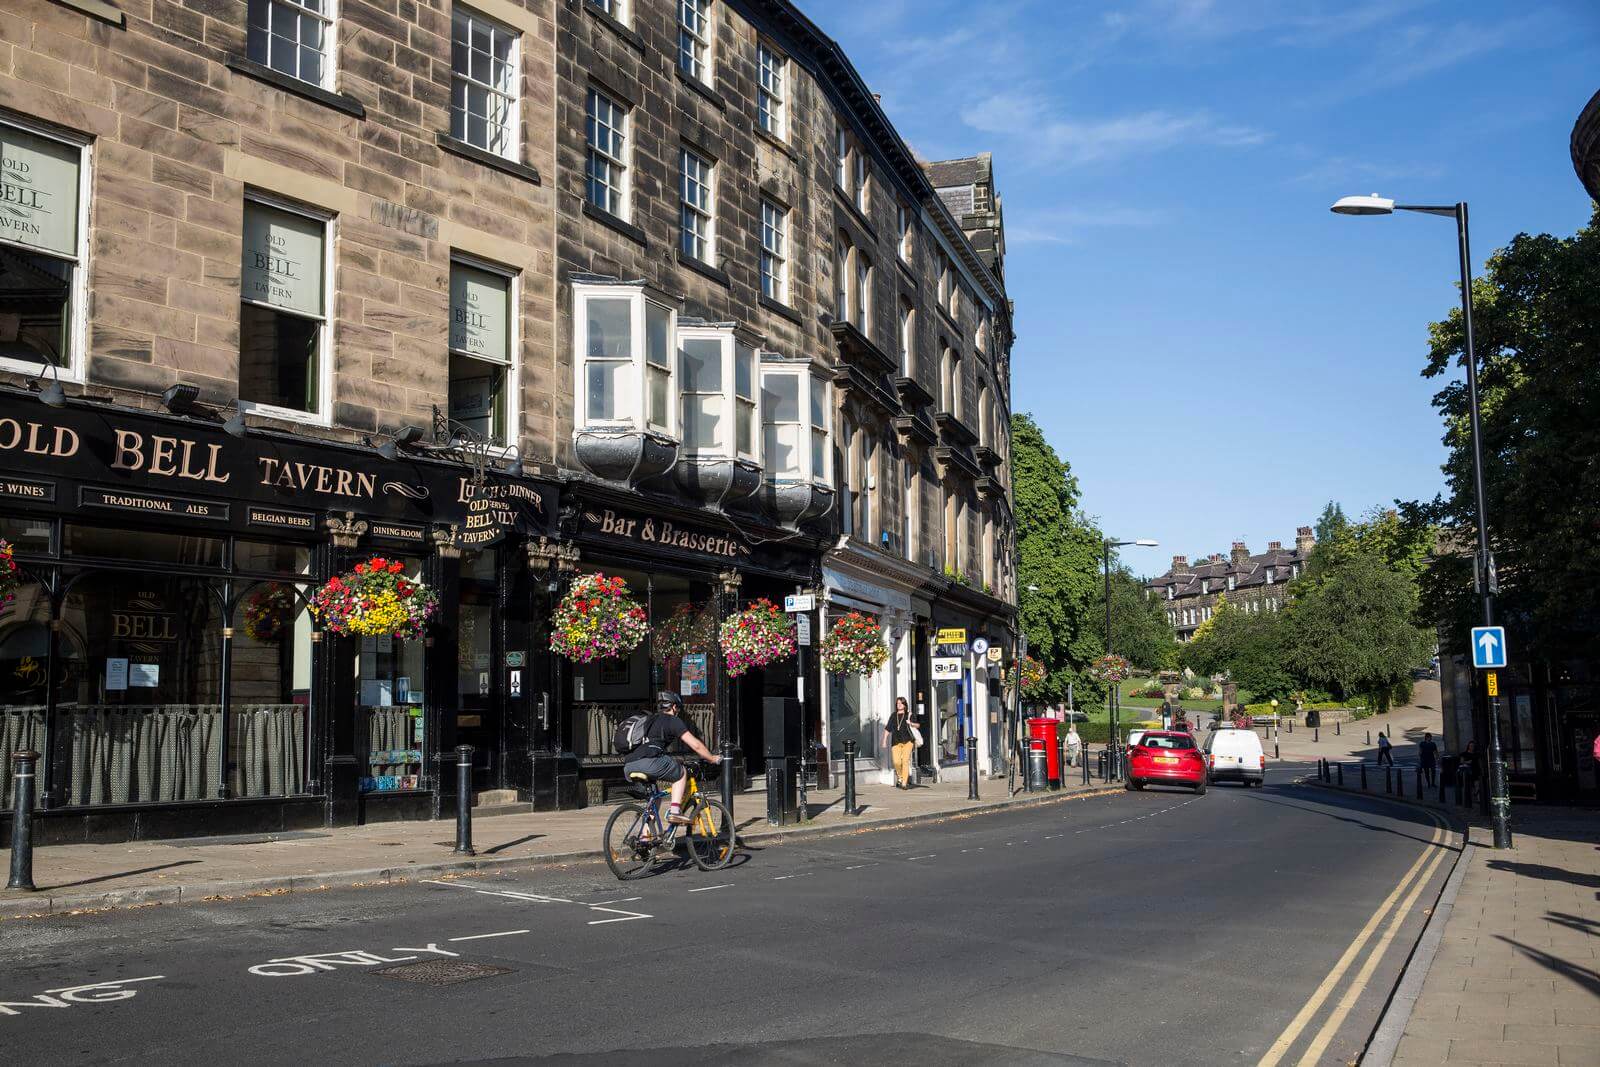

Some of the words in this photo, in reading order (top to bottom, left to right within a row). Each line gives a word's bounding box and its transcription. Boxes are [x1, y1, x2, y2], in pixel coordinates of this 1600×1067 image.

[2, 157, 30, 174] OLD
[265, 233, 286, 247] OLD
[254, 252, 295, 277] BELL
[255, 281, 293, 300] TAVERN
[455, 307, 487, 329] BELL
[455, 334, 485, 348] TAVERN
[0, 418, 80, 457] OLD
[110, 429, 230, 483] BELL
[258, 456, 377, 499] TAVERN
[7, 483, 45, 497] WINES
[457, 477, 499, 503] LUCH
[508, 484, 543, 514] DINNER
[102, 494, 173, 512] TRADITIONAL
[186, 503, 209, 516] ALES
[469, 499, 489, 512] OLD
[252, 512, 286, 525] BELGIAN
[288, 516, 311, 527] BEERS
[465, 513, 494, 529] BELL
[372, 525, 400, 537] DINING
[400, 528, 422, 539] ROOM
[462, 528, 496, 543] TAVERN
[600, 509, 637, 538] Bar
[640, 517, 656, 542] &
[658, 521, 738, 558] Brasserie
[112, 614, 178, 639] BELL
[247, 943, 460, 977] ONLY
